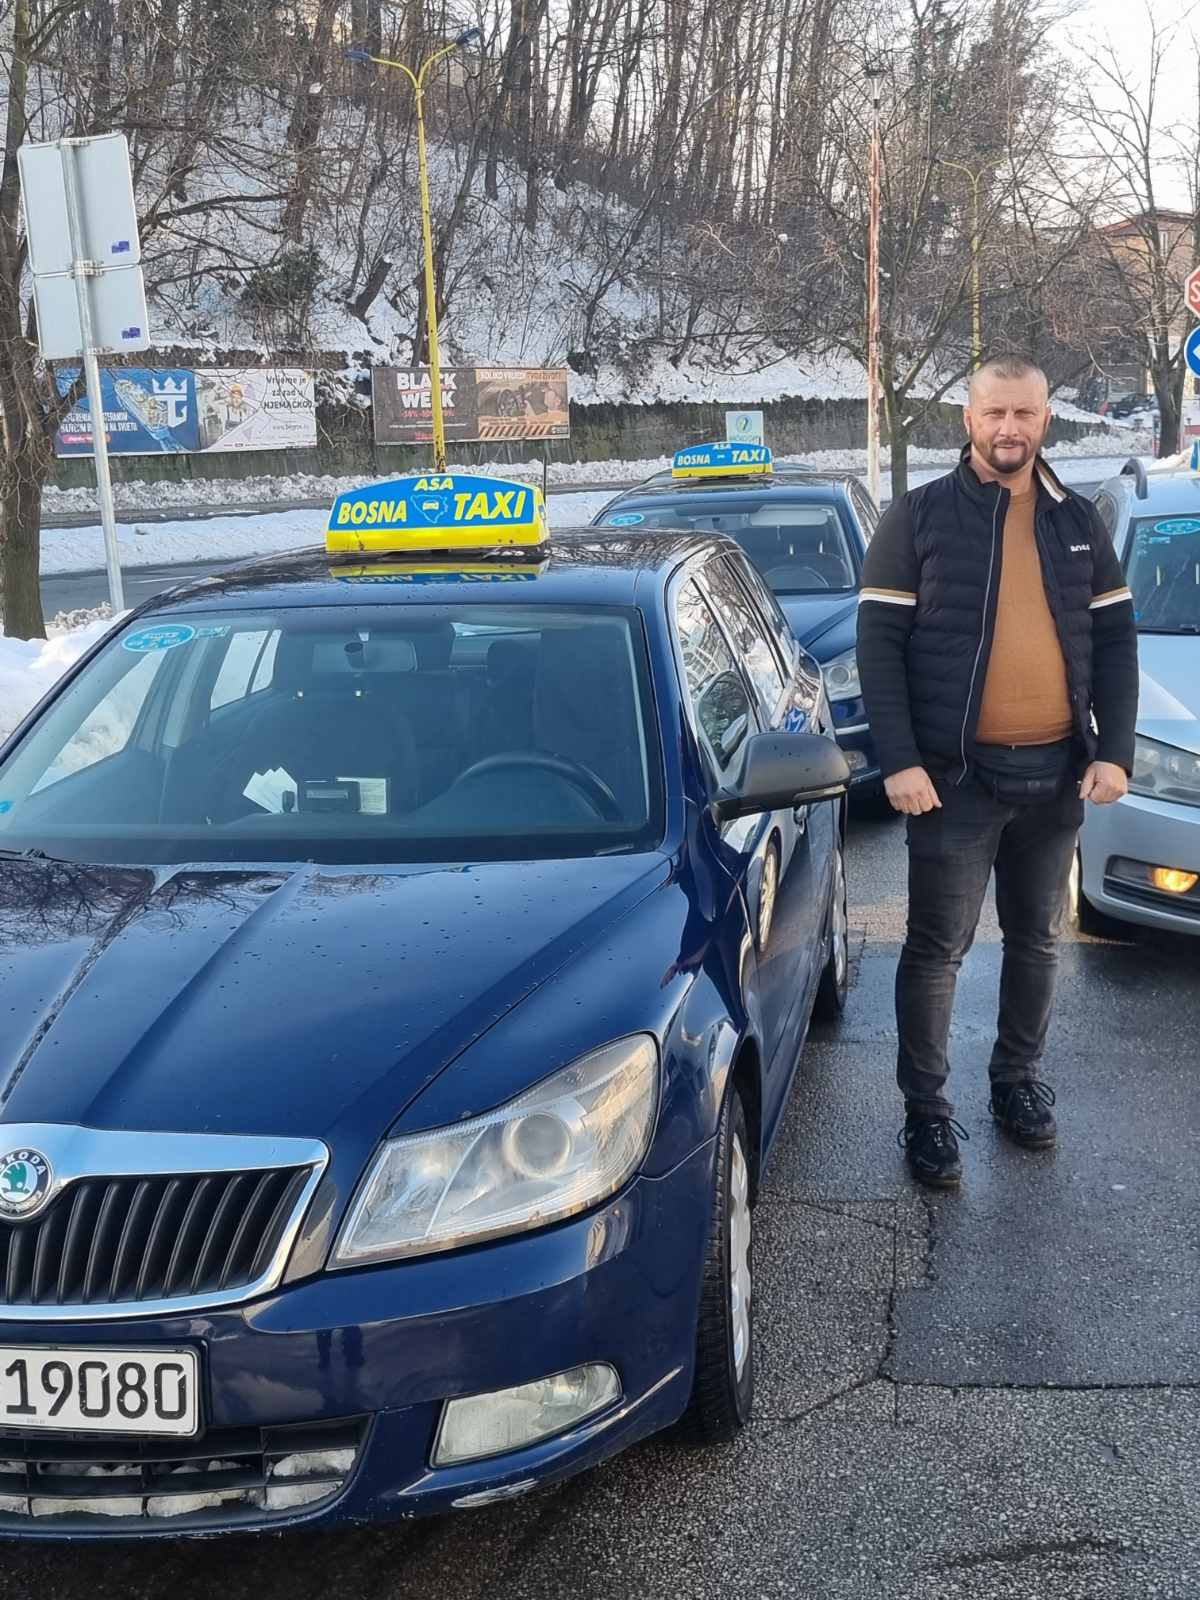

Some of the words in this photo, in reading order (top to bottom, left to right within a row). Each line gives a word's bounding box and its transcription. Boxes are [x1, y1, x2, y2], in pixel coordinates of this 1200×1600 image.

[401, 391, 455, 408] WEK
[677, 454, 711, 466] BOSNA
[731, 449, 766, 463] TAXI
[414, 478, 454, 492] ASA
[337, 501, 407, 525] BOSNA
[454, 491, 526, 520] TAXI
[5, 1358, 187, 1420] 19080
